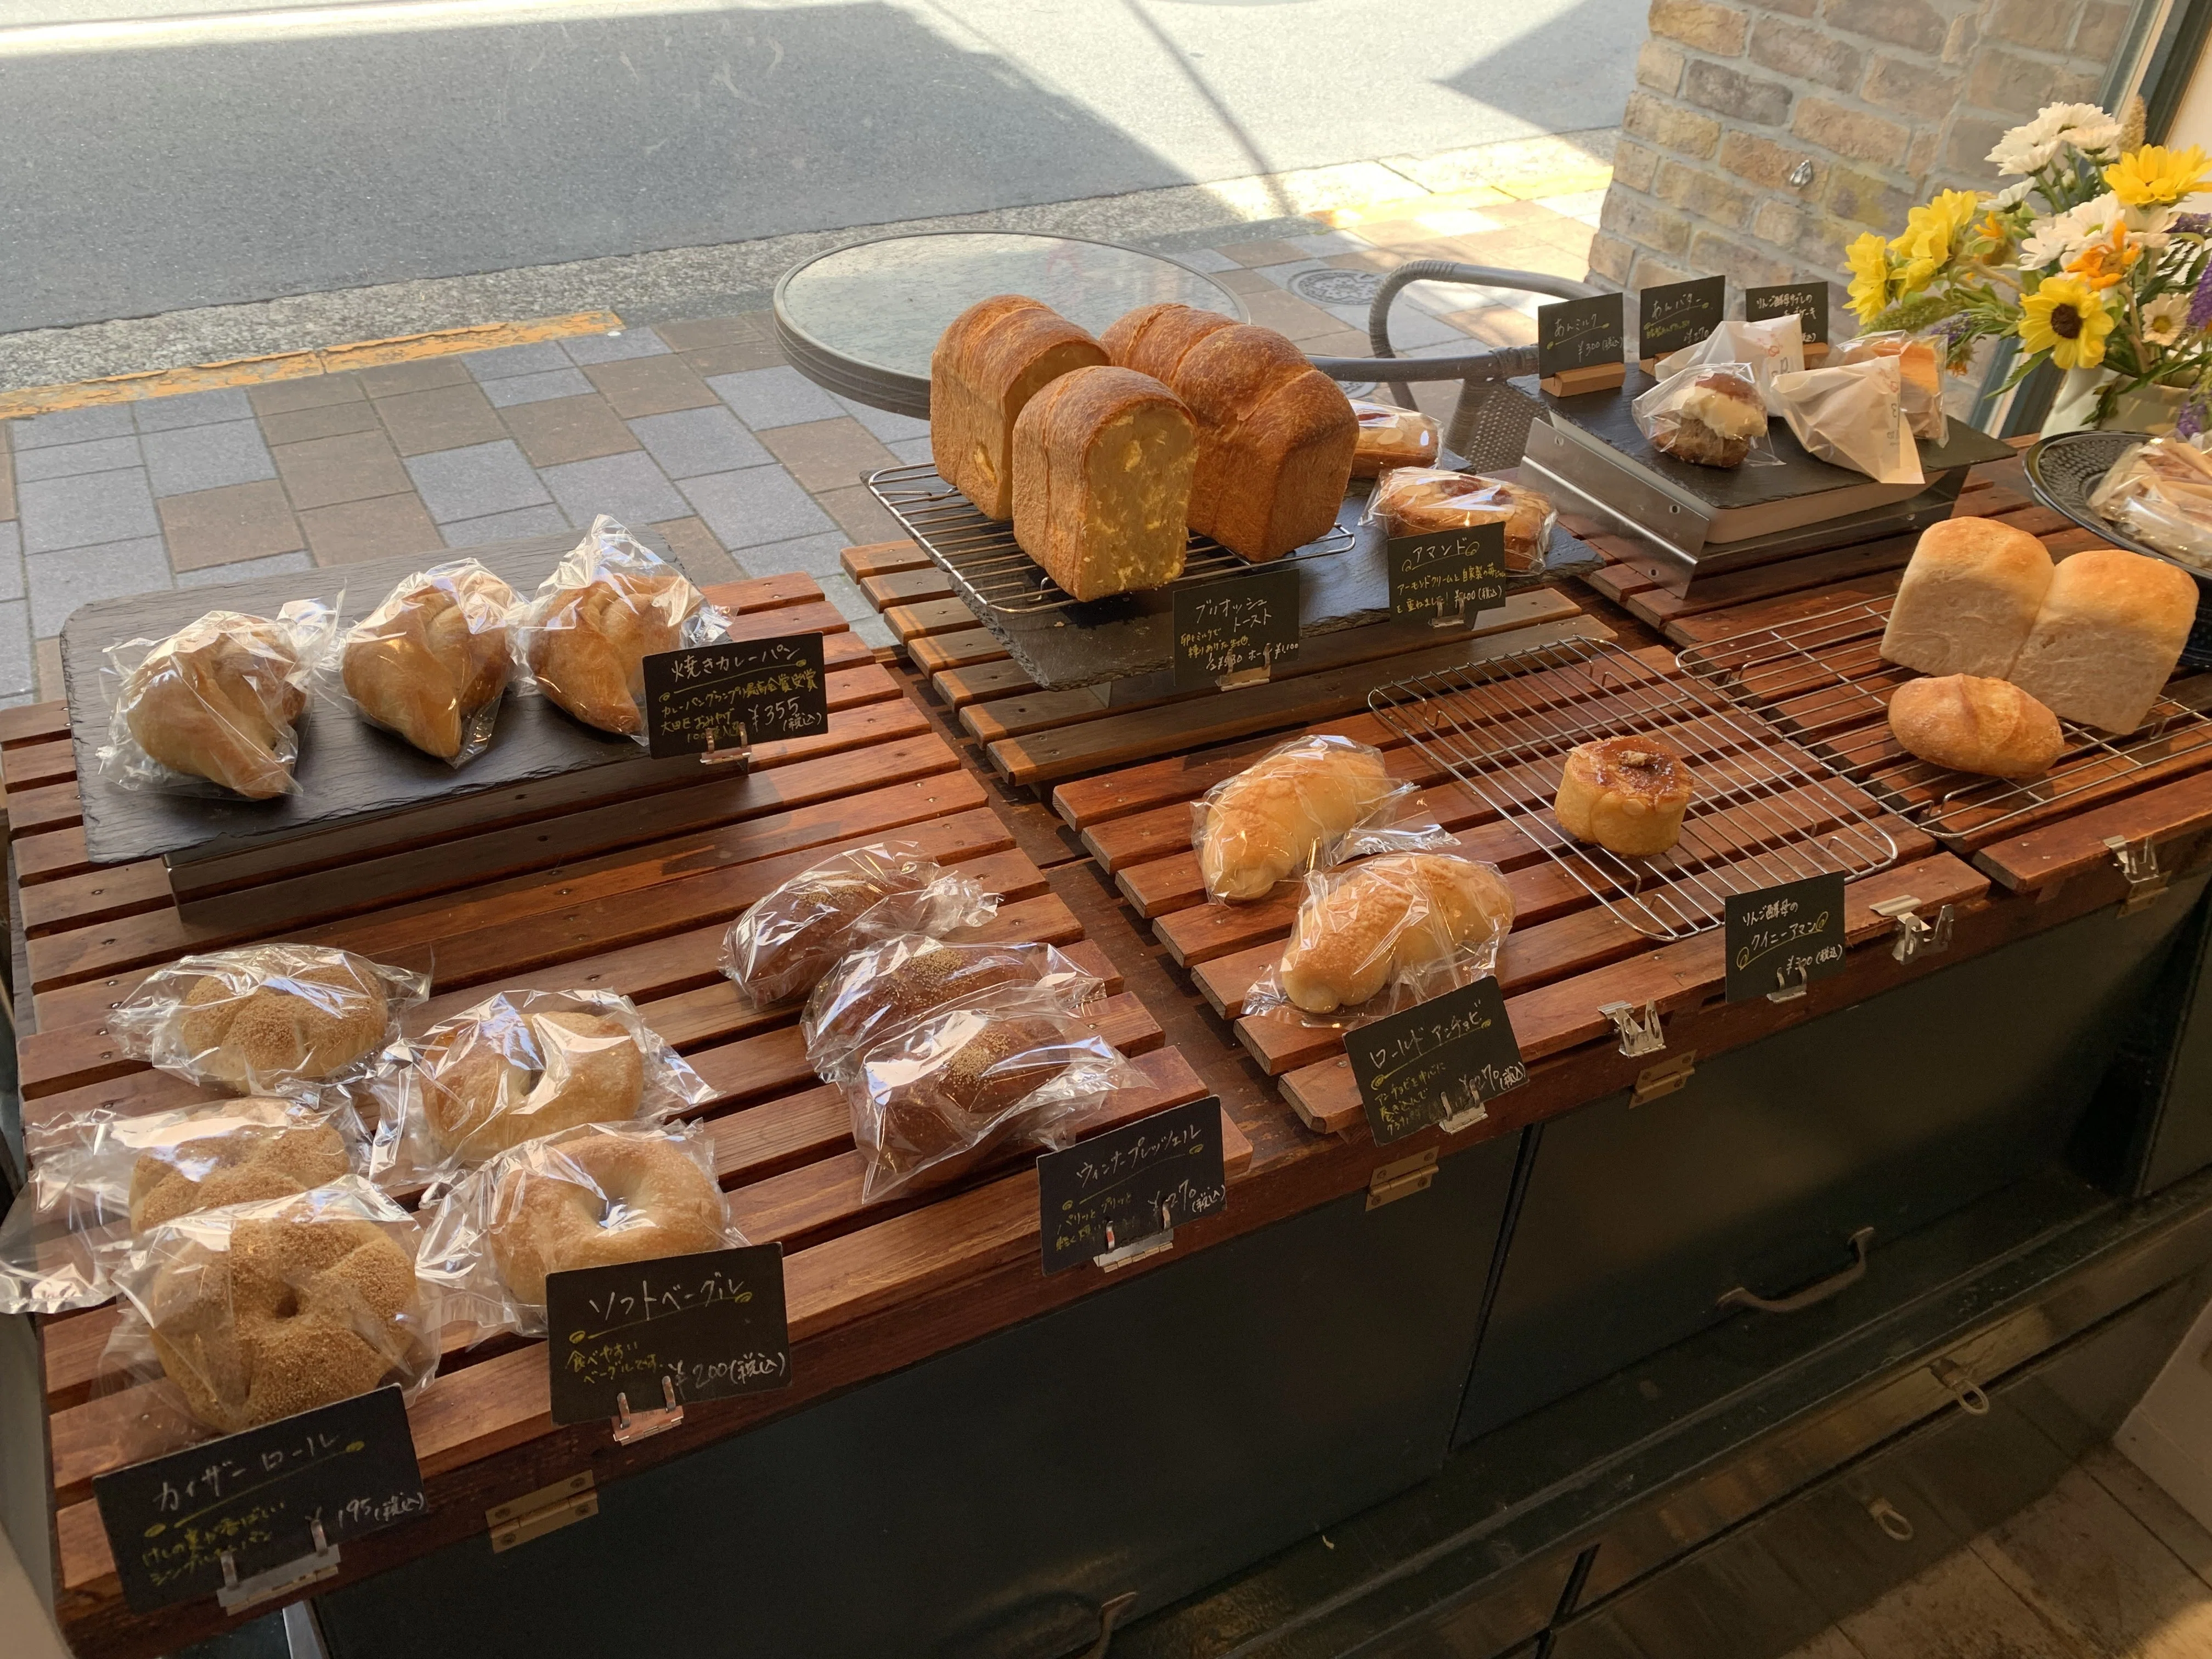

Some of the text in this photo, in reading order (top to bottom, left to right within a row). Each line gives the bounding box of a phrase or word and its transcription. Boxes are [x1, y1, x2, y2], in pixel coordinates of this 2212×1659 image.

[1651, 293, 1702, 319] あんバター
[1554, 313, 1597, 337] あんミルク
[1412, 537, 1467, 563] アマンド
[1195, 597, 1267, 624] ブリオッシュ
[1233, 608, 1272, 633] トースト
[672, 644, 800, 682] 焼きカレーパン
[783, 712, 822, 732] (税込)
[1742, 898, 1798, 926] りんご酵母の
[1751, 922, 1817, 951] クイニーアマン
[589, 1271, 744, 1321] ソフトベーグル
[566, 1341, 638, 1372] 食べやすい
